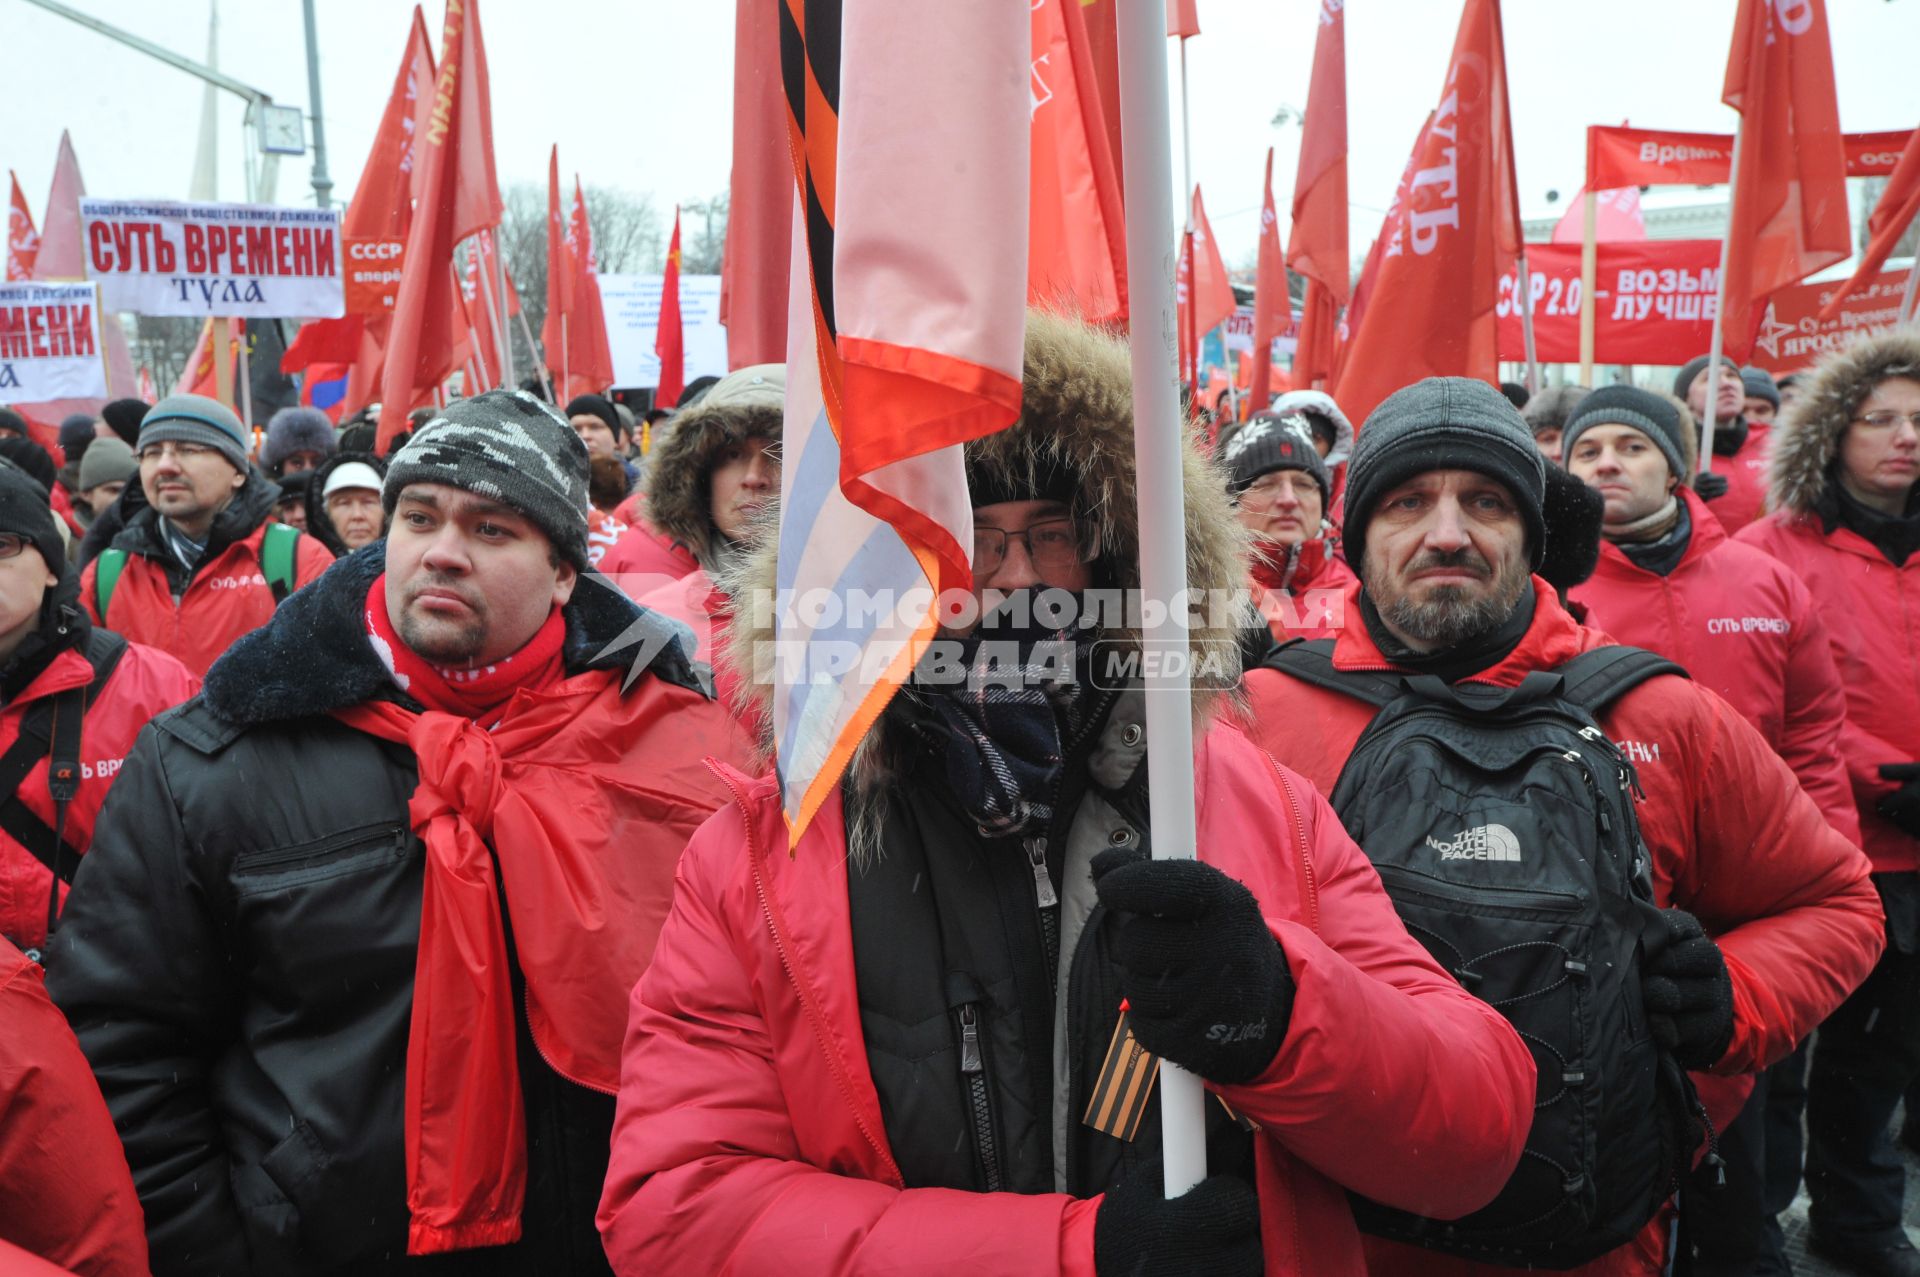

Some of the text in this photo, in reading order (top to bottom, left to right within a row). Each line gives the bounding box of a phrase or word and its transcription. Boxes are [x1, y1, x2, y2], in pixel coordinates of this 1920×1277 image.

[191, 207, 277, 221] ОБЩЕСТВЕННОЕ
[279, 210, 336, 223] ДВИЖЕНИЕ
[89, 220, 177, 273] СУТЬ
[183, 223, 336, 277] ВРЕМЕНИ
[351, 243, 402, 260] СССР
[1545, 277, 1583, 316] 2.0
[1707, 618, 1741, 634] СУТЬ
[1453, 825, 1487, 842] THE
[1425, 834, 1487, 853] NORTH
[1441, 846, 1487, 861] FACE
